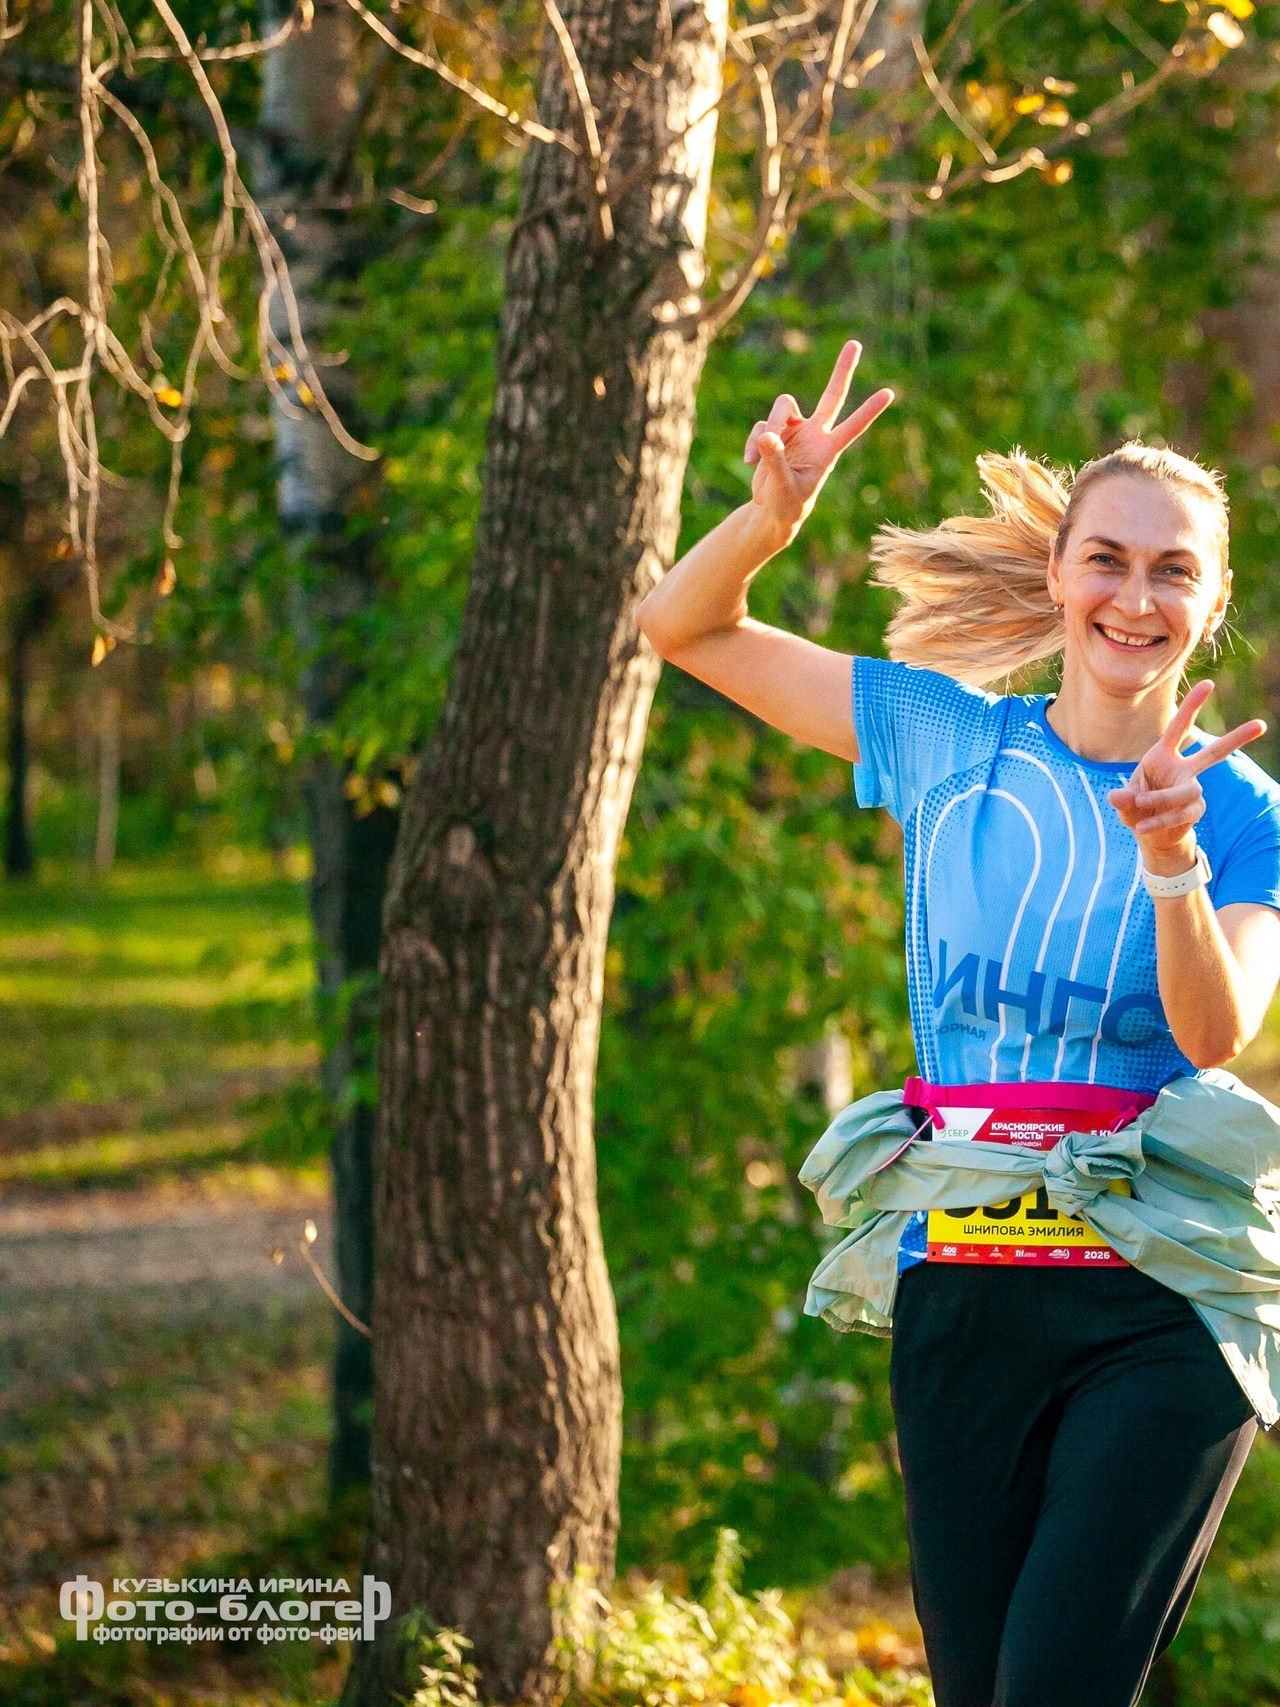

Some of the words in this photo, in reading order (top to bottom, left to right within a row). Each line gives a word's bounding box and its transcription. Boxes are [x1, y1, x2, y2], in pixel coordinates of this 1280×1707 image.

[935, 1023, 986, 1041] ОРНАЯ
[991, 1122, 1065, 1132] КРАСНОЯРСКИЕ
[948, 1129, 969, 1137] СБЕР
[1010, 1131, 1044, 1140] МОСТЫ
[963, 1224, 1025, 1236] ШНИПОВА
[1028, 1226, 1084, 1237] ЭМИЛИЯ
[942, 1245, 957, 1254] 400
[1084, 1250, 1111, 1260] 2026
